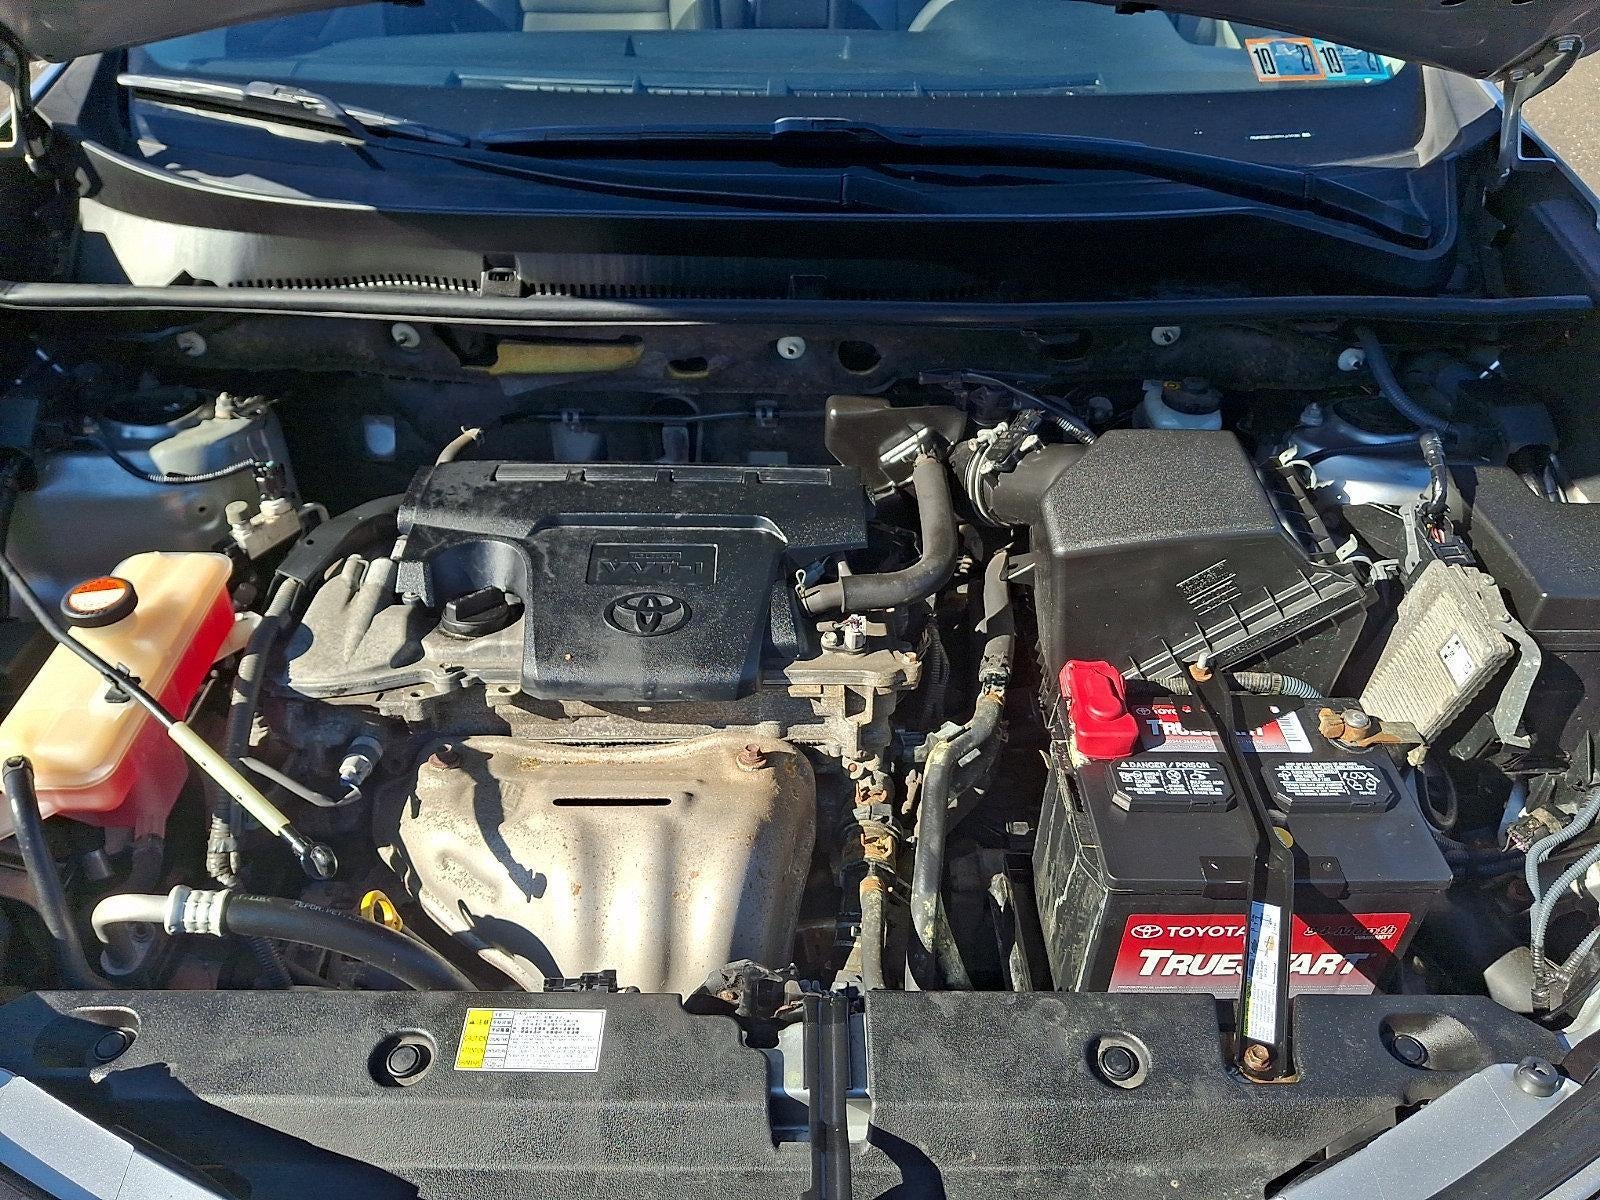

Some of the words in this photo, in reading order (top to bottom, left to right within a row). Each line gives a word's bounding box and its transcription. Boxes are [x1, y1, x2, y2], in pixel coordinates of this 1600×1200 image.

[1129, 761, 1167, 769] DANGER
[1175, 761, 1210, 769] POISON
[1166, 925, 1246, 937] TOYOTA
[1138, 948, 1370, 976] TRUEART
